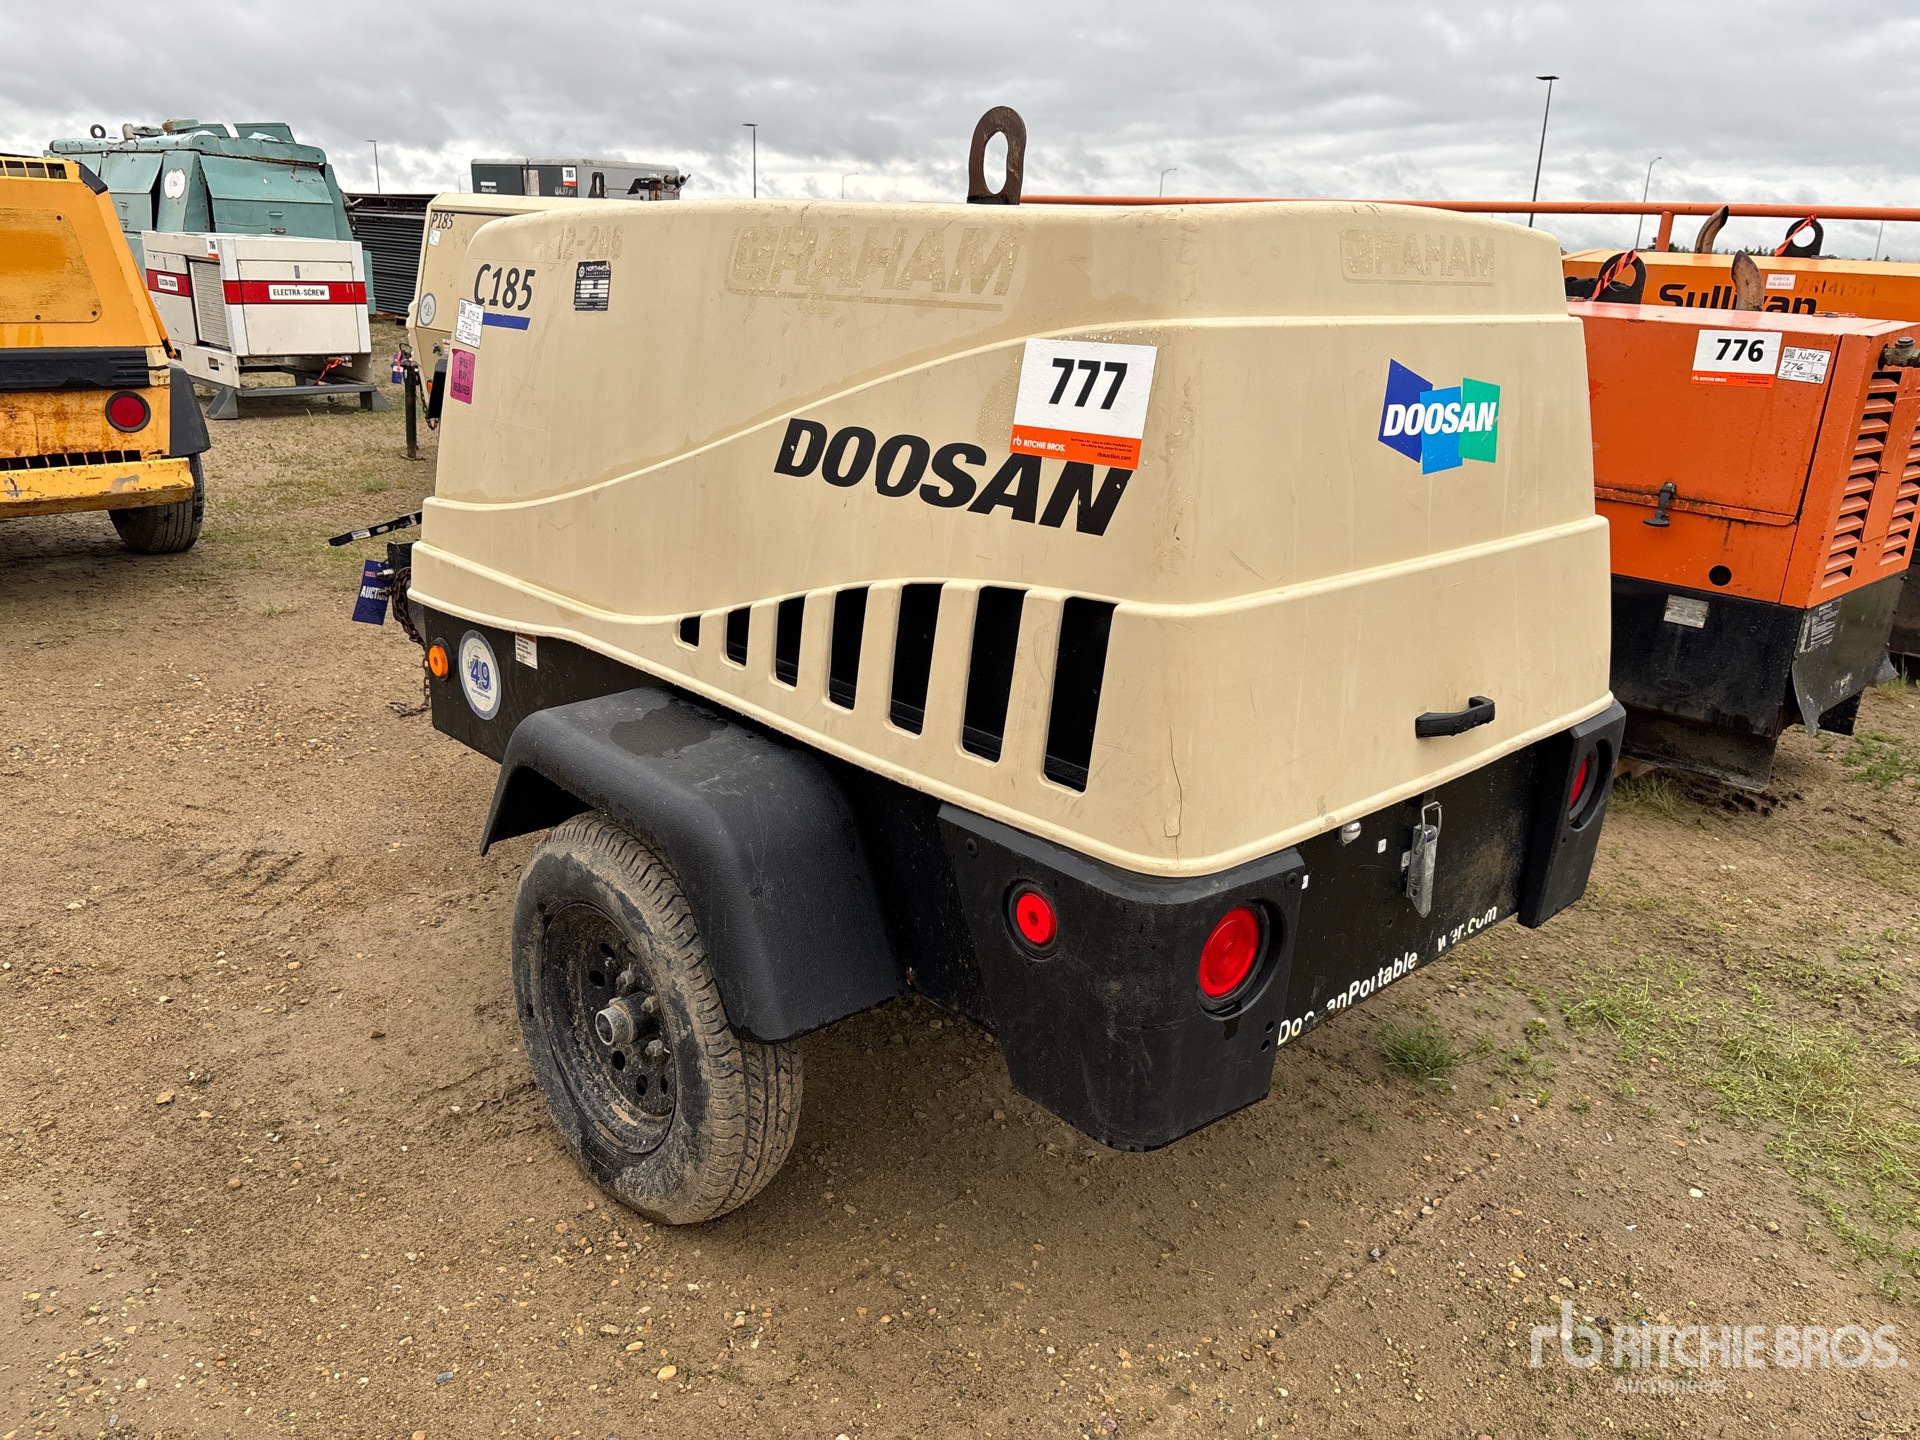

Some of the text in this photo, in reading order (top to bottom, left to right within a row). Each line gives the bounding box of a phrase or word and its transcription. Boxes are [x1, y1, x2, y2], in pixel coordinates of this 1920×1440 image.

[430, 213, 455, 230] P185
[732, 224, 1018, 297] GRAHAM
[1345, 228, 1495, 278] GRAHAM
[273, 288, 326, 297] ELECTRA-SCREW
[473, 263, 536, 311] C185
[1716, 338, 1765, 362] 776
[1797, 351, 1825, 362] N242
[1784, 361, 1804, 371] 776
[1049, 357, 1128, 410] 777
[1382, 400, 1499, 438] DOOSAN
[1012, 435, 1022, 446] rb
[1023, 439, 1046, 450] RITCHIE
[1047, 442, 1066, 452] BROS.
[1097, 452, 1132, 462] rbauction.com
[774, 417, 1133, 536] DOOSAN
[470, 659, 491, 690] 49
